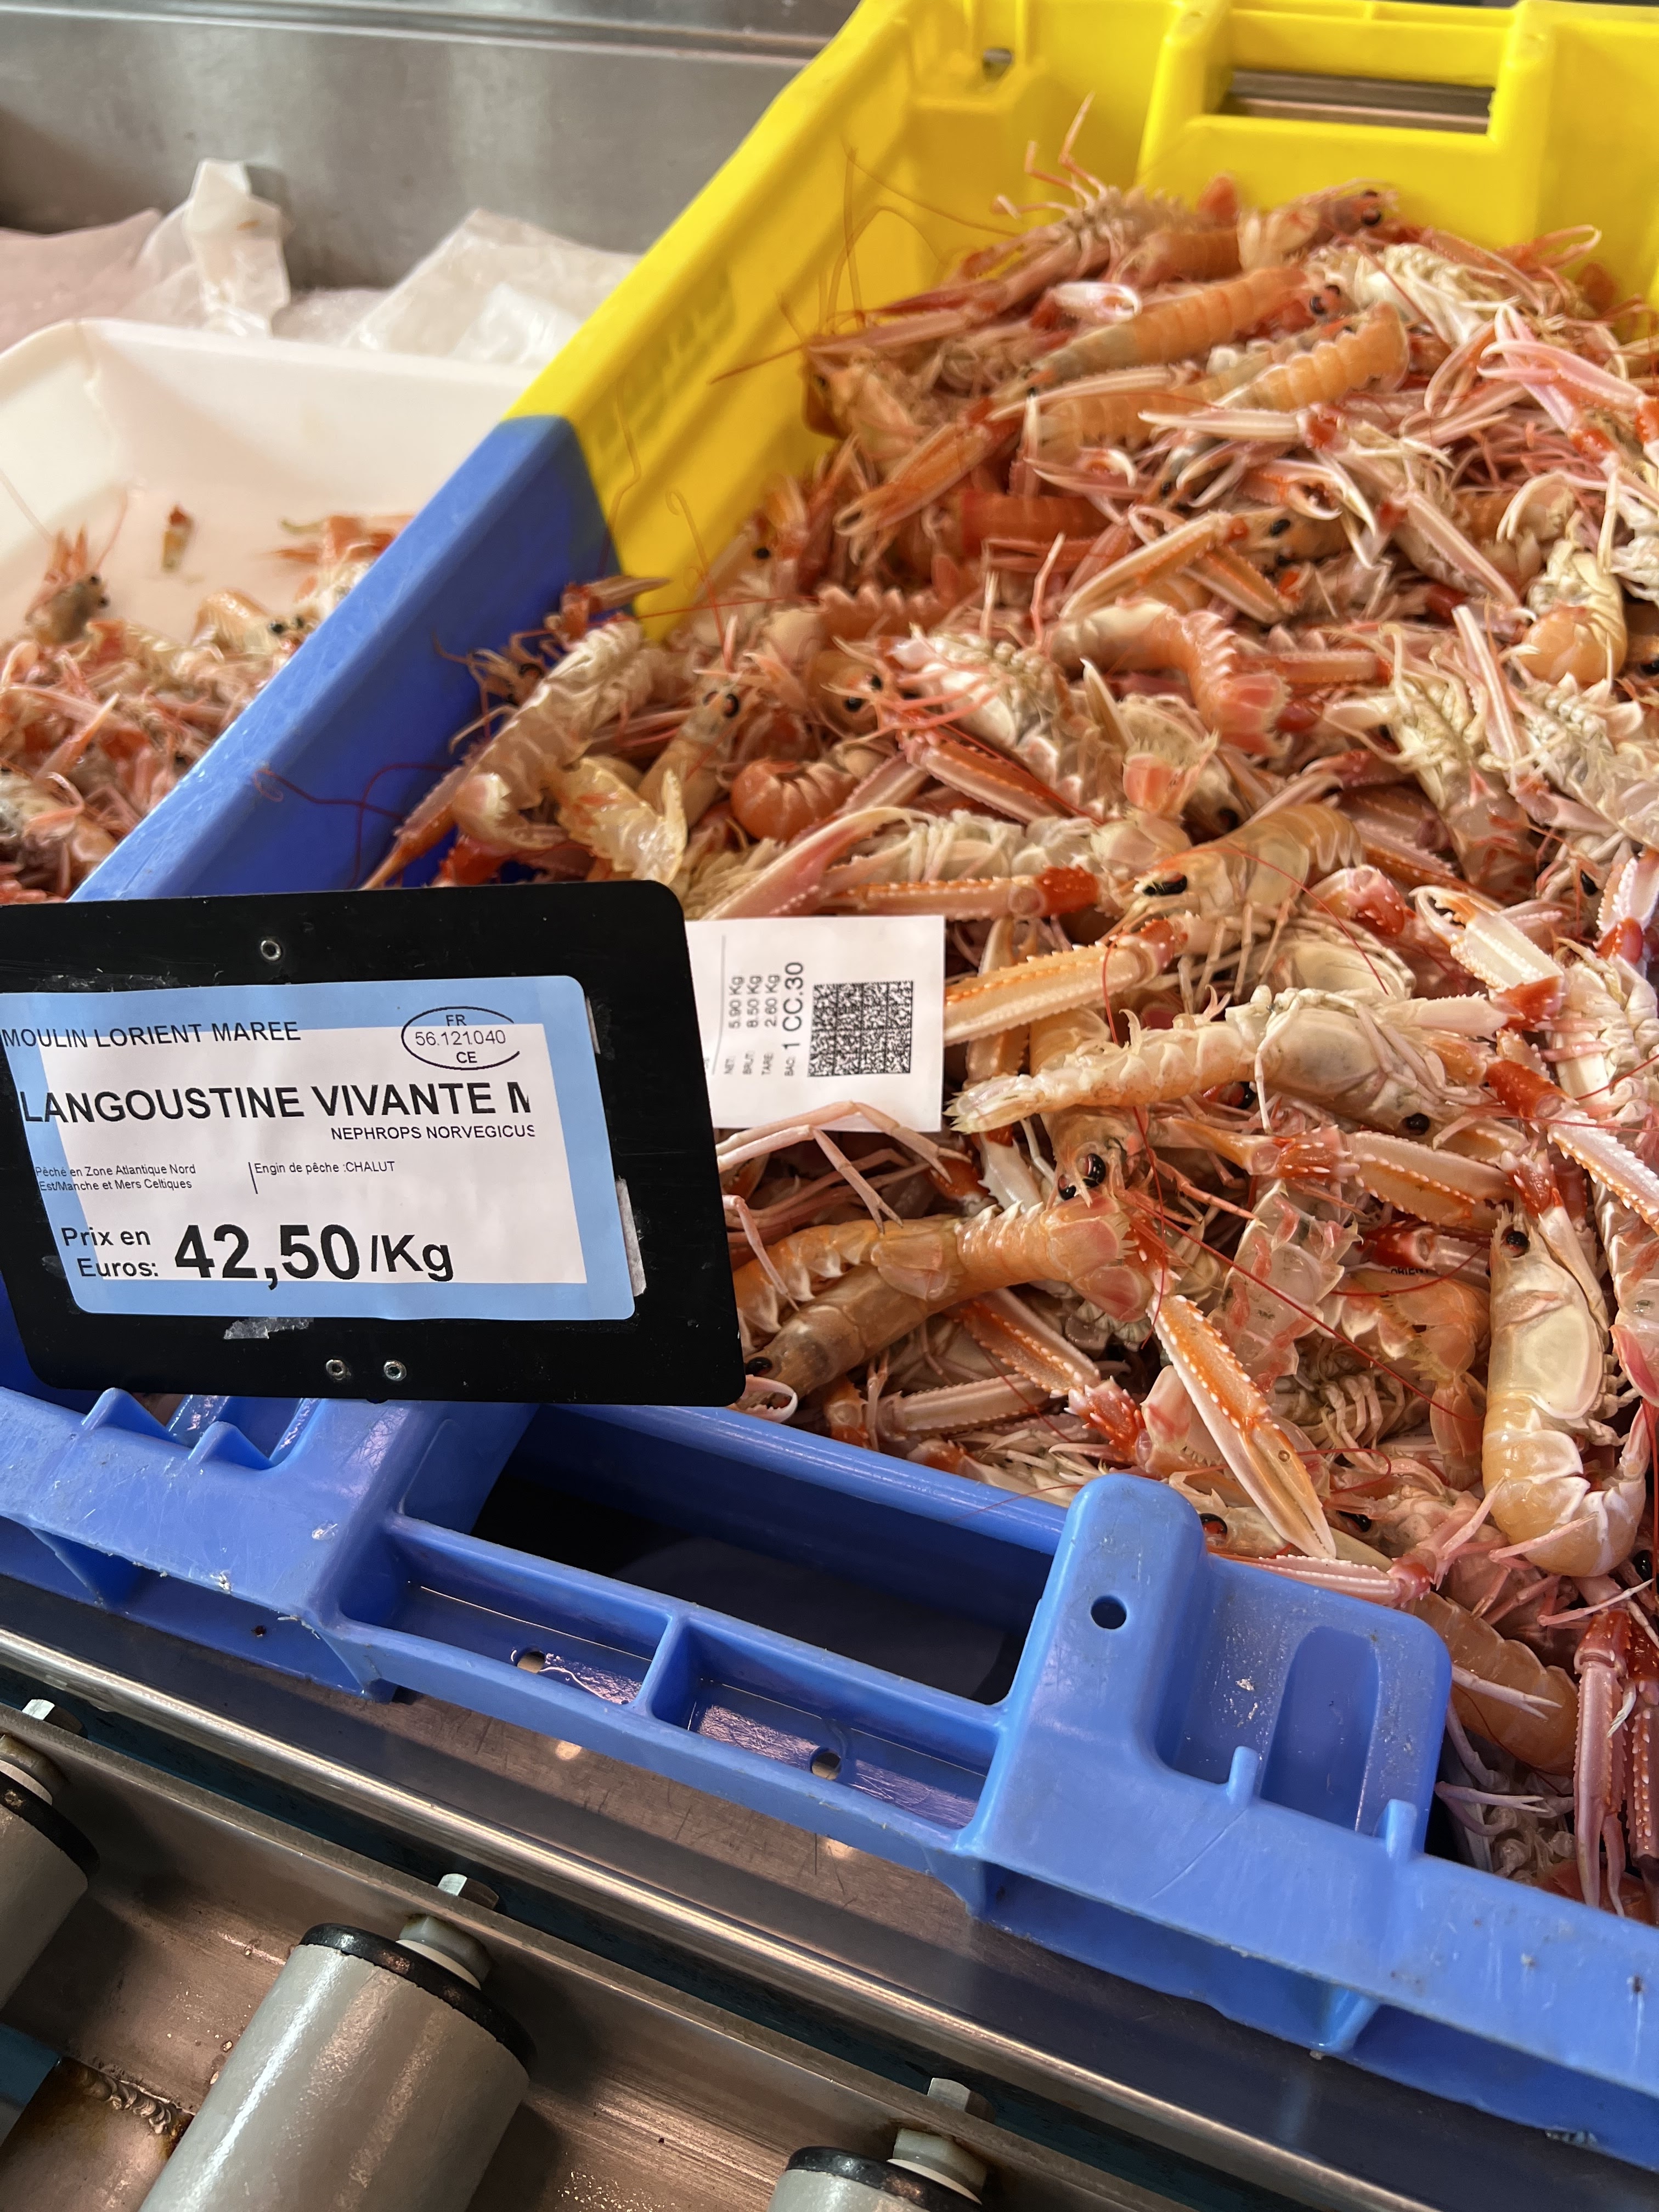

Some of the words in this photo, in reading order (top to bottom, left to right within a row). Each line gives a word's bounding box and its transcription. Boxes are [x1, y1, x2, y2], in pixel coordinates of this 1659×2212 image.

[729, 976, 745, 995] Kg
[747, 974, 763, 994] Kg
[765, 974, 781, 993] Kg
[782, 962, 803, 1031] CC.30
[445, 1014, 467, 1027] FR
[2, 1029, 88, 1048] MOULIN
[94, 1024, 202, 1048] LORIENT
[211, 1022, 301, 1042] MAREE
[456, 1051, 478, 1064] CE
[20, 1087, 305, 1123] LANGOUSTINE
[310, 1082, 496, 1117] VIVANTE
[330, 1126, 422, 1140] NEPHROPS
[426, 1124, 535, 1139] NORVEGICUS
[85, 1166, 114, 1177] Zone
[115, 1164, 167, 1177] Atlantique
[169, 1164, 196, 1175] Nord
[254, 1163, 286, 1176] Engin
[289, 1162, 303, 1173] de
[305, 1162, 340, 1175] pêche
[39, 1180, 100, 1191] Est/Manche
[102, 1180, 113, 1190] et
[114, 1179, 142, 1189] Mers
[144, 1178, 192, 1191] Celtiques
[60, 1226, 114, 1246] Prix
[120, 1230, 151, 1246] en
[76, 1257, 159, 1277] Euros:
